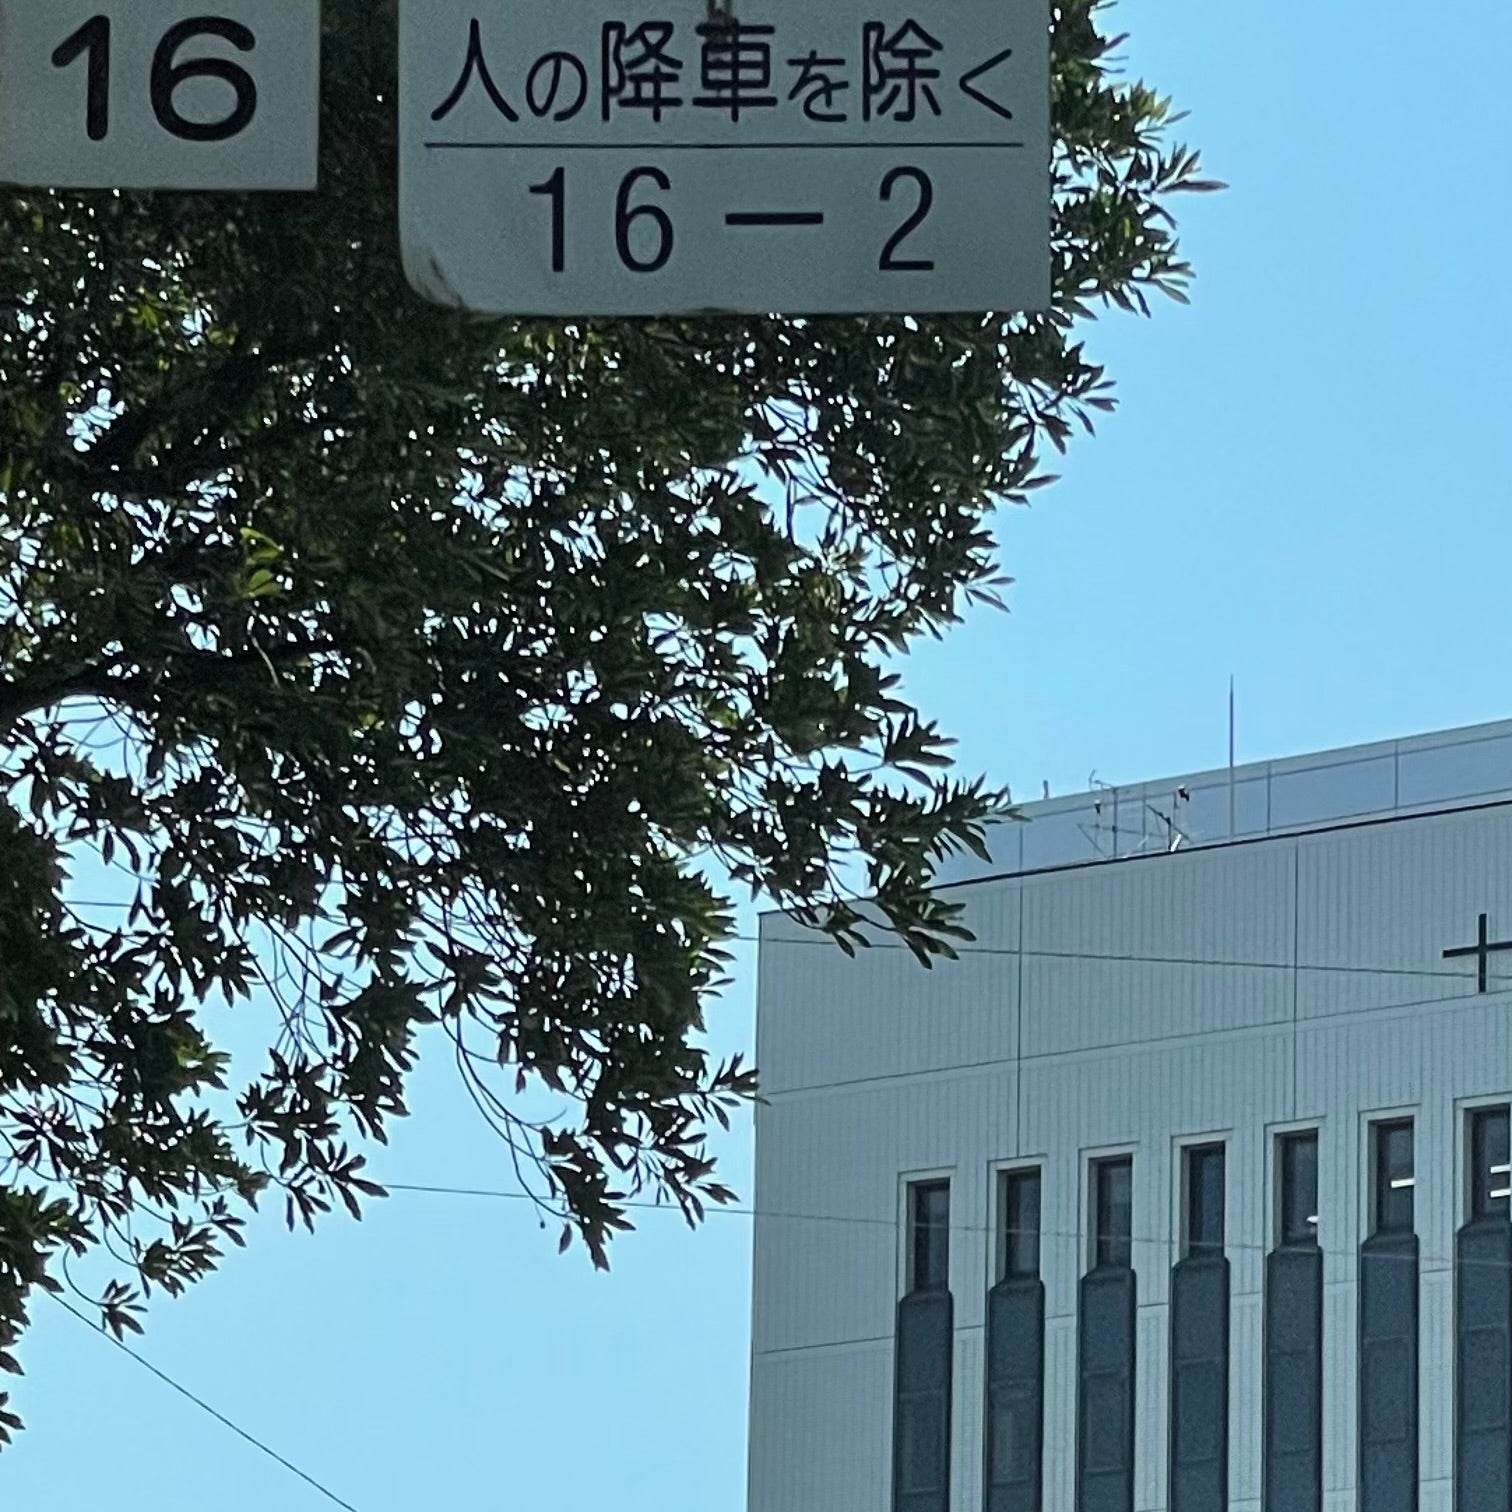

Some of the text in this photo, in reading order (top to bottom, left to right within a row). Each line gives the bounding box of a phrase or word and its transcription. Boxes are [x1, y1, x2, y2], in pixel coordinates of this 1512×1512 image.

[49, 15, 259, 143] 16
[430, 17, 1015, 123] 人の降車を除く
